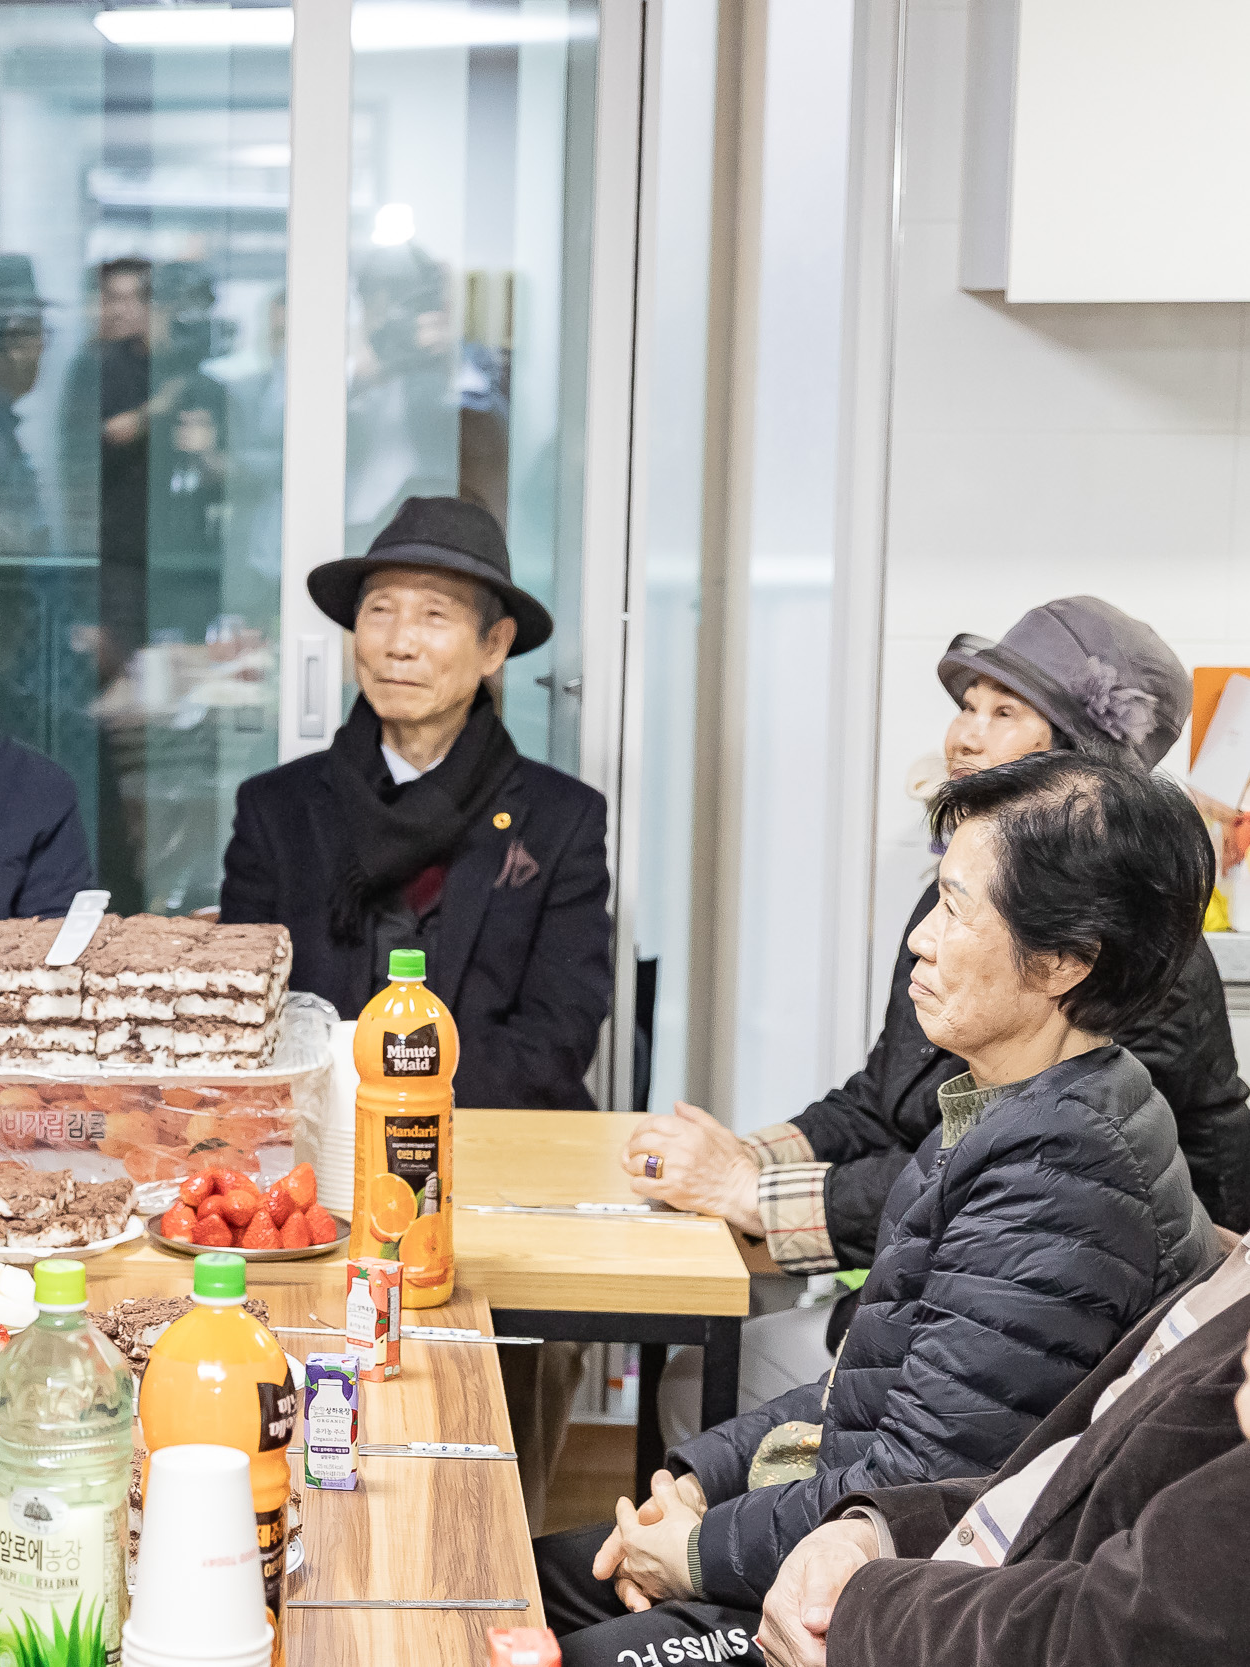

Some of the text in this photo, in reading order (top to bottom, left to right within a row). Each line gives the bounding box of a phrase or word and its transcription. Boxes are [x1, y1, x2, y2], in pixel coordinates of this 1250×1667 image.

[386, 1045, 437, 1058] Minute
[393, 1058, 431, 1072] Maid
[325, 1407, 350, 1416] 상하목장
[315, 1428, 332, 1436] 유기농
[0, 1530, 83, 1573] 알로에농장
[0, 1568, 17, 1584] PULPY
[35, 1578, 54, 1589] VERA
[56, 1578, 79, 1590] DRINK
[617, 1628, 749, 1667] SWISS FC
